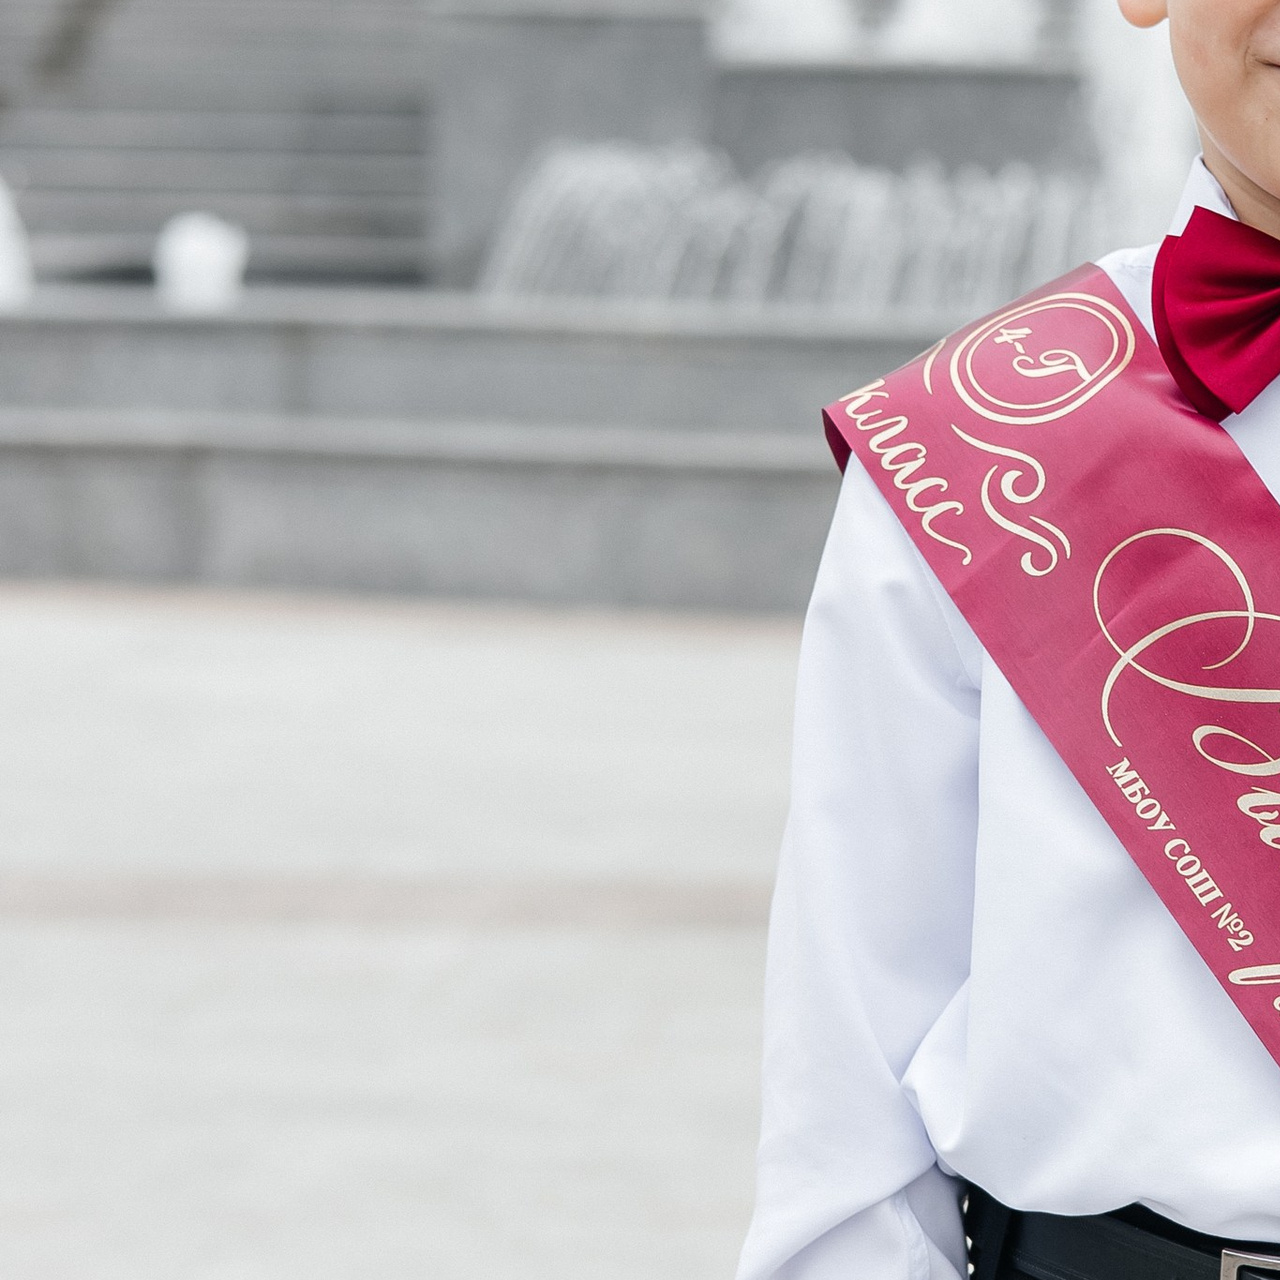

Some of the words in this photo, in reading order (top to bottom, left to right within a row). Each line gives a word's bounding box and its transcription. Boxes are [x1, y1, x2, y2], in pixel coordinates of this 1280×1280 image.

[1105, 756, 1177, 831] МБОУ
[1163, 837, 1225, 907] СОШ
[1210, 901, 1255, 953] №2
